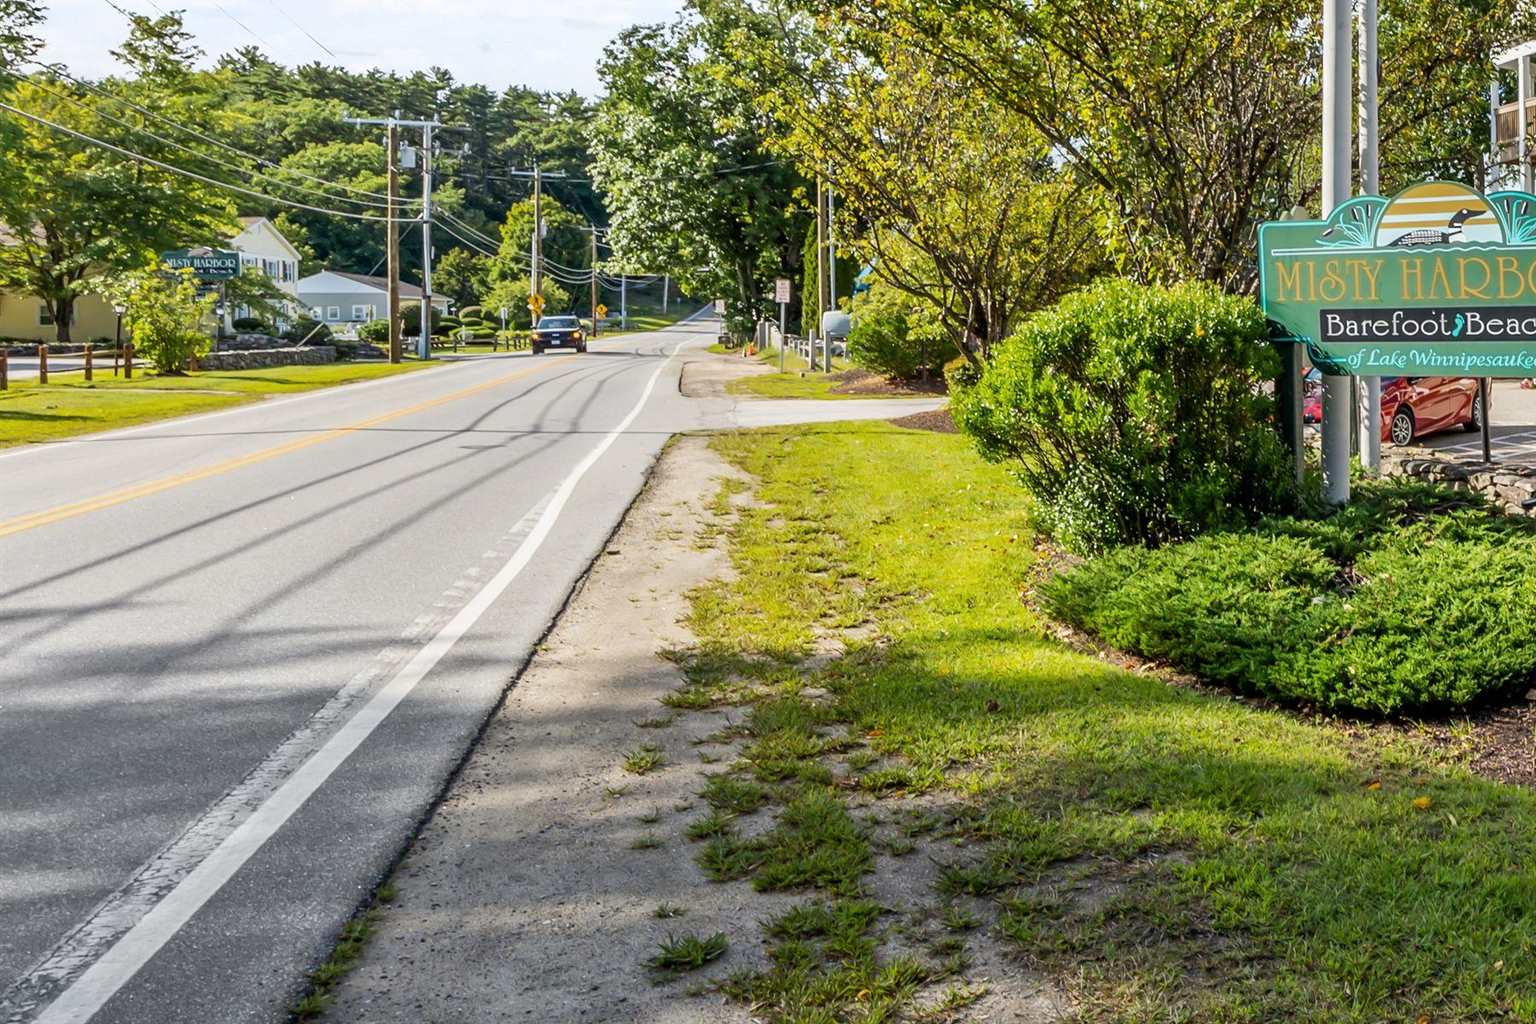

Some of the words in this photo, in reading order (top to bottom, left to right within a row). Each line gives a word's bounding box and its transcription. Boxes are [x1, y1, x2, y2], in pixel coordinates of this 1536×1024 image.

[193, 257, 236, 268] HARBOR
[1275, 259, 1385, 303] MISTY
[1326, 310, 1452, 337] Barefoot
[1347, 349, 1366, 369] of
[1367, 349, 1407, 367] Lake
